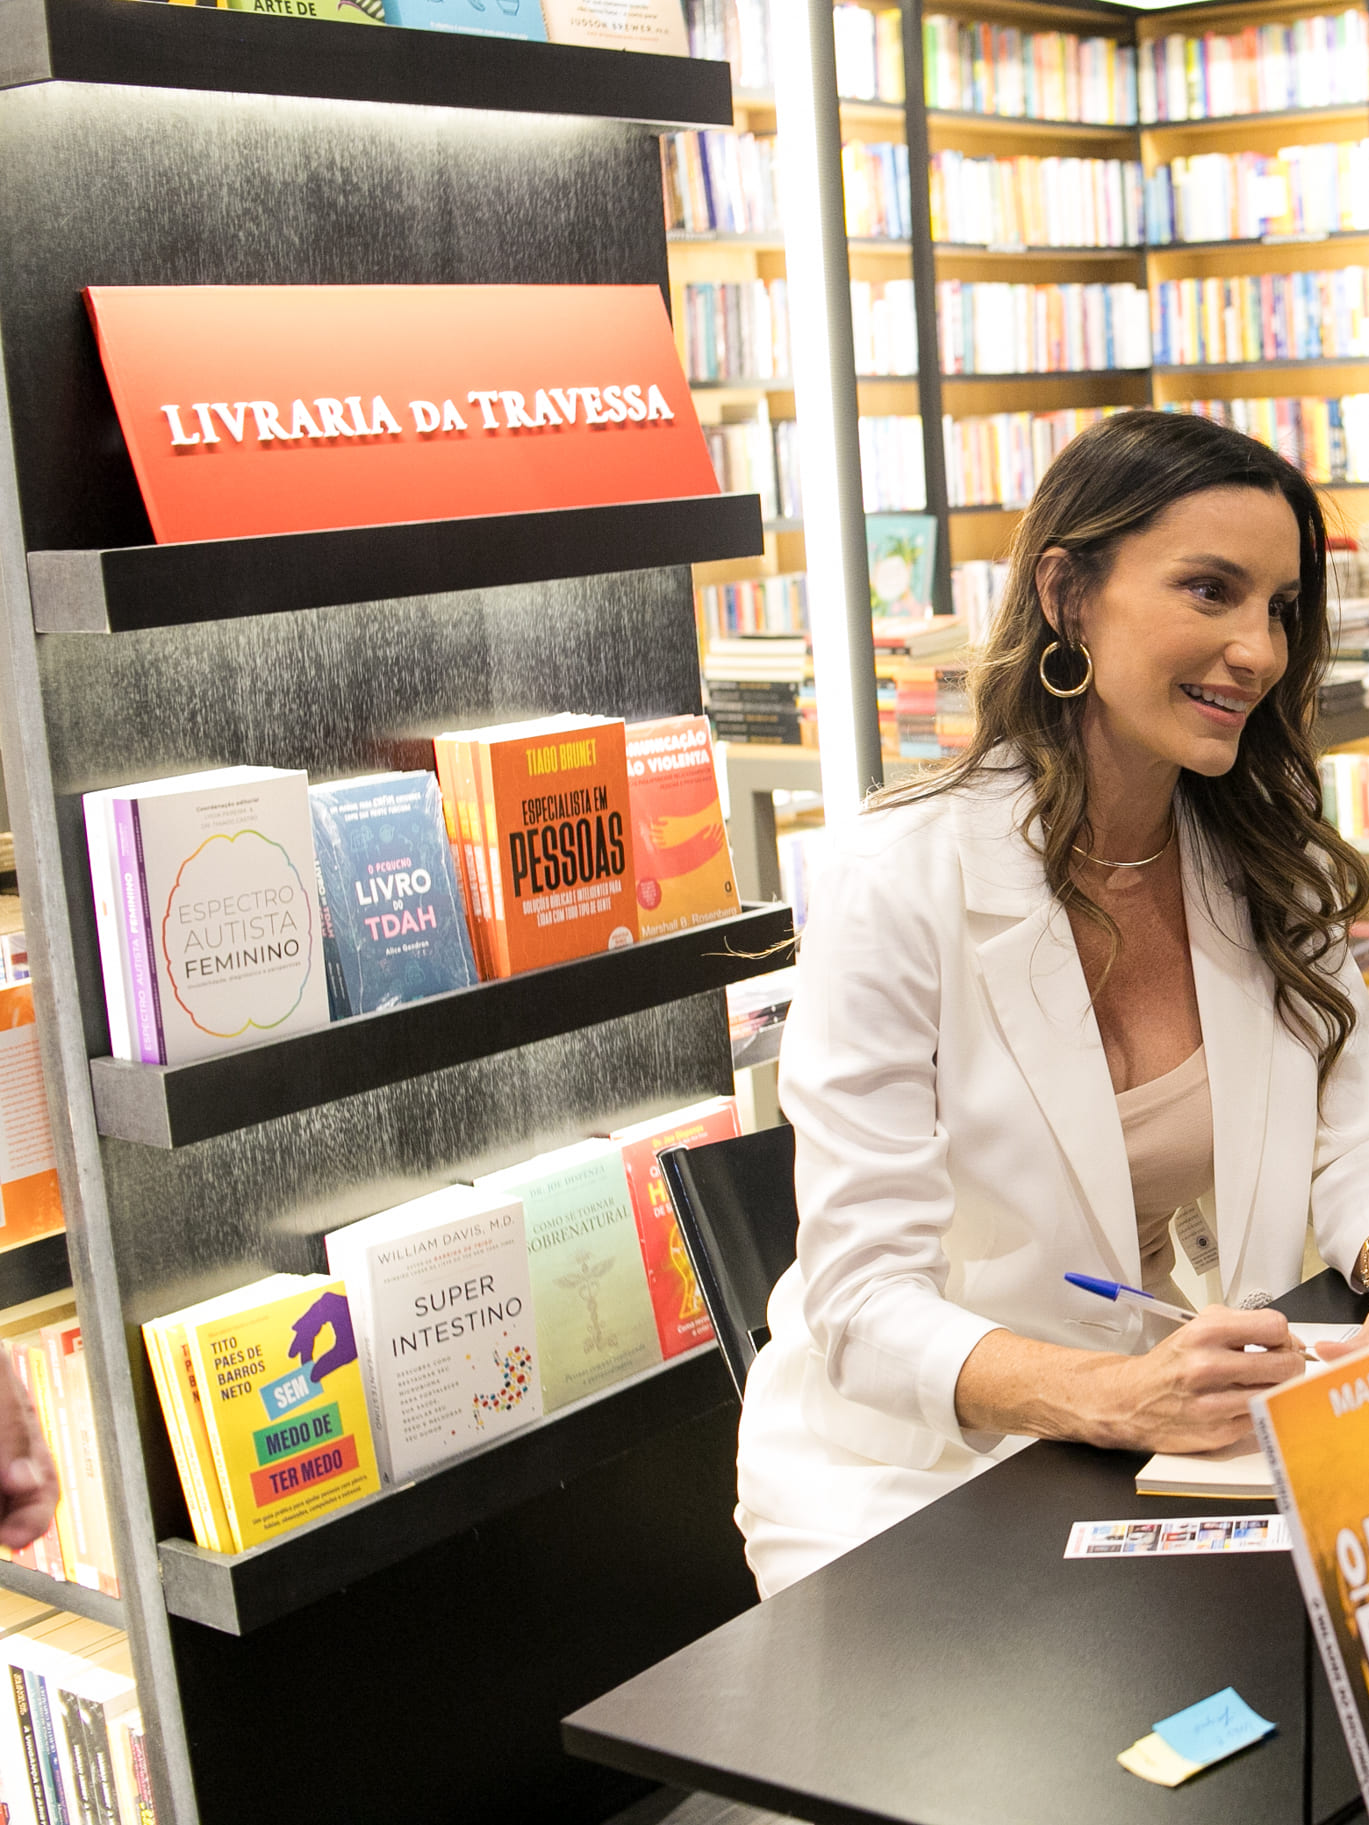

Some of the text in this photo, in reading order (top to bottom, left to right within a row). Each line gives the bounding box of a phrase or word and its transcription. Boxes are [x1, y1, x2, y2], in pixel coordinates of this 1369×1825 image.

[253, 0, 317, 16] ARTE DE
[161, 384, 675, 447] LIVRARIA DA TRAVESSA
[525, 738, 597, 777] TIAGO BRUNET
[626, 729, 707, 758] MUNICAÇÃO
[626, 758, 645, 777] ÃO
[647, 749, 710, 773] VIOLENTA
[521, 784, 608, 826] ESPECIALISTA EM
[367, 864, 374, 875] O
[509, 811, 625, 898] PESSOAS
[124, 872, 139, 934] FEMININO
[178, 885, 294, 925] ESPECTRO
[355, 868, 432, 906] LIVRO
[392, 899, 404, 912] DO
[184, 910, 297, 954] AUTISTA
[364, 904, 437, 941] TDAH
[641, 919, 678, 937] Marshall
[692, 907, 738, 924] Rosenberg
[185, 938, 300, 979] FEMININO
[385, 946, 401, 956] Alice
[138, 990, 152, 1051] ESPECTRO
[532, 1215, 563, 1235] COMO
[577, 1195, 615, 1216] TORNAR
[377, 1214, 515, 1266] WILLIAM DAVIS, M.D.
[414, 1274, 496, 1318] SUPER
[210, 1336, 238, 1355] TITO
[391, 1296, 523, 1358] INTESTINO
[214, 1344, 263, 1371] PAES DE
[217, 1360, 266, 1386] BARROS
[220, 1381, 252, 1402] NETO
[273, 1374, 310, 1410] SEM
[265, 1413, 333, 1456] MEDO DE
[268, 1449, 343, 1494] TER MEDO
[1335, 1527, 1369, 1587] O
